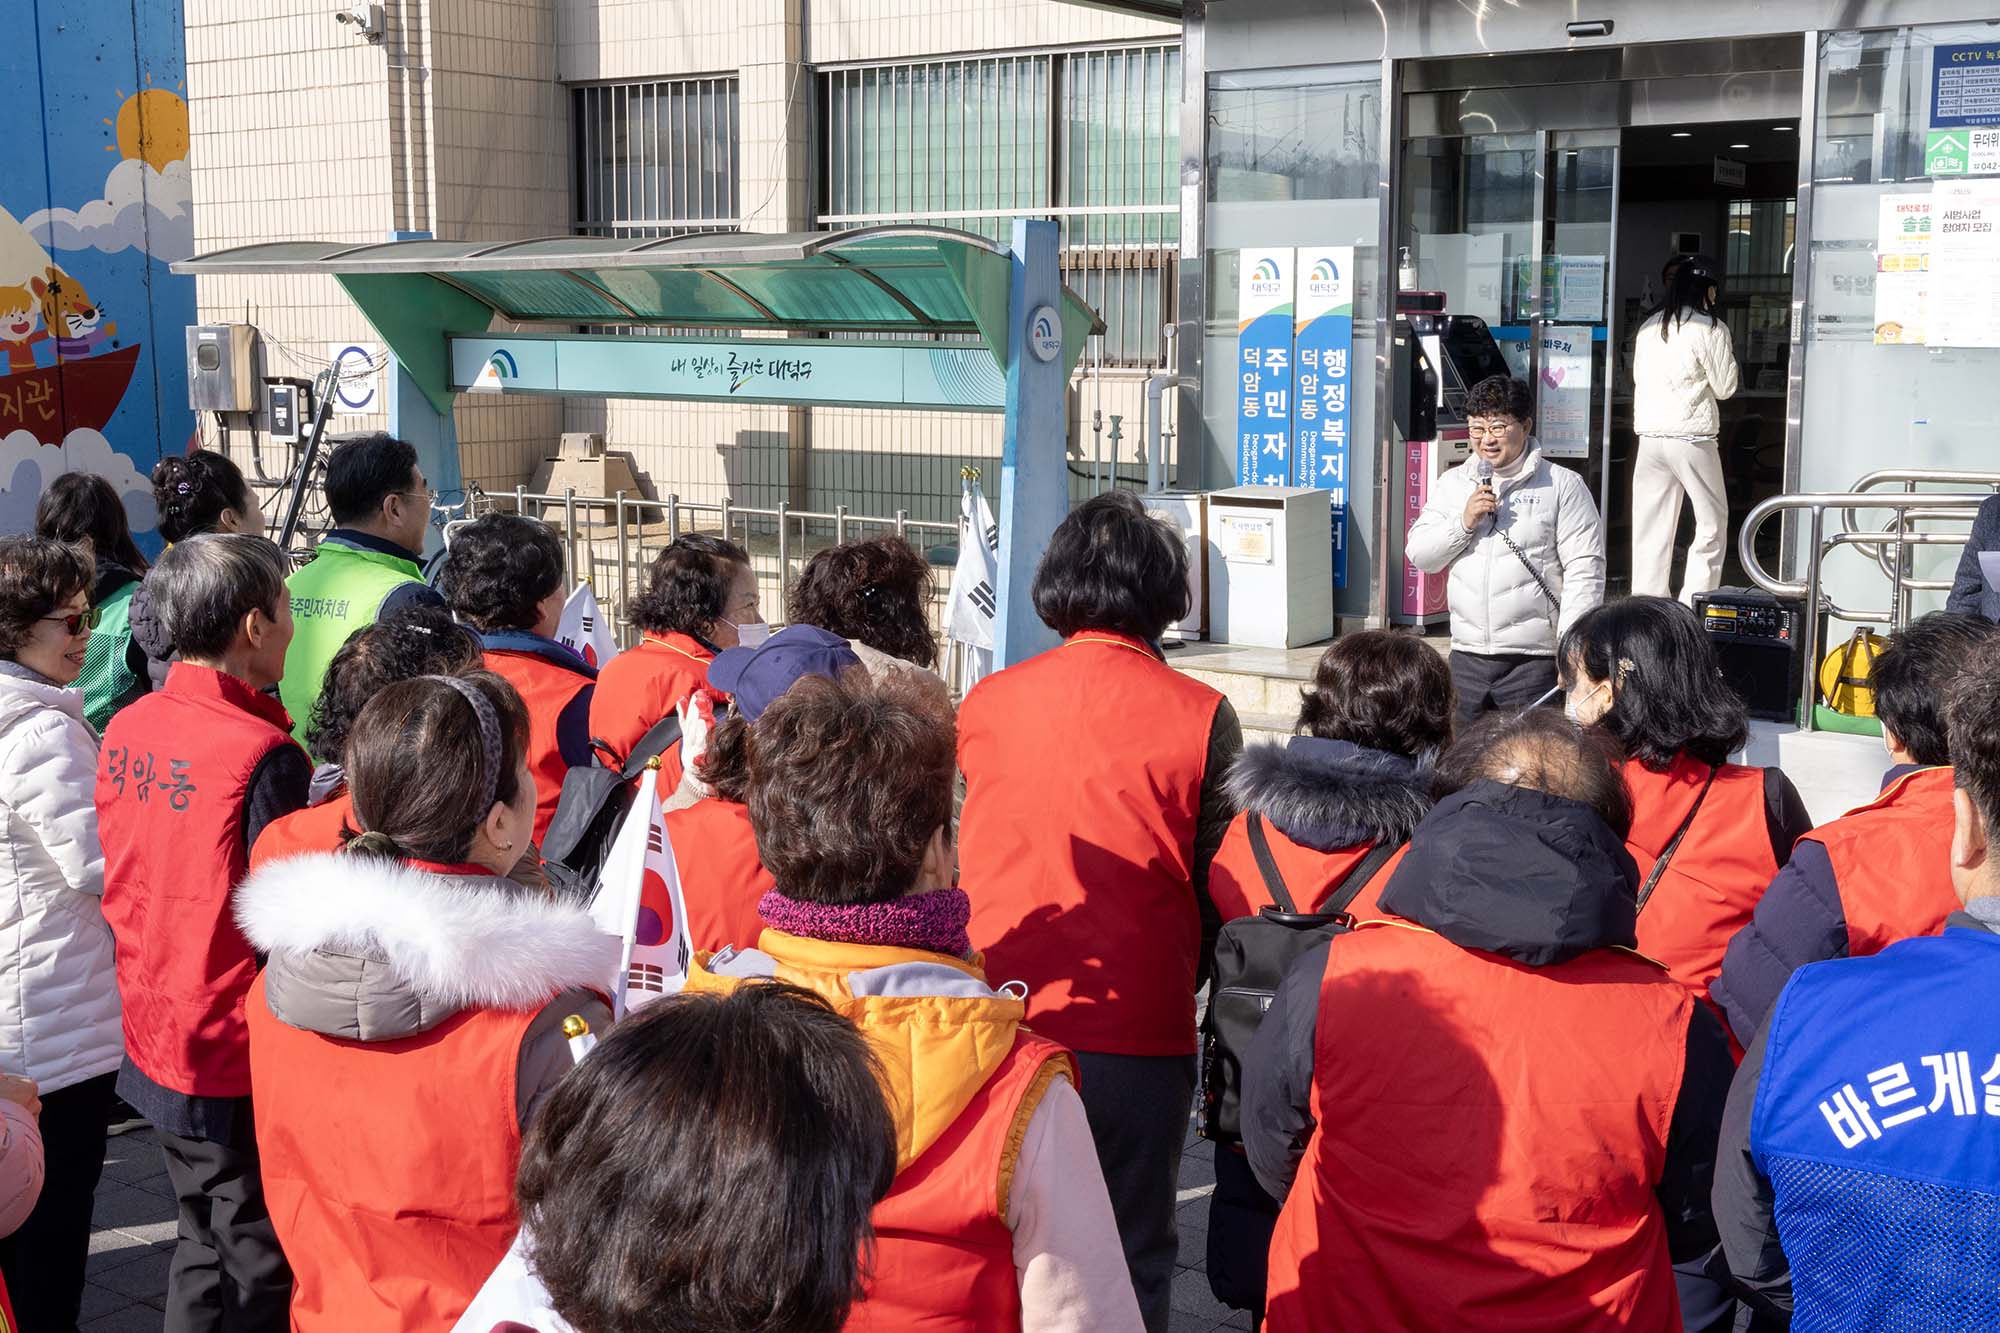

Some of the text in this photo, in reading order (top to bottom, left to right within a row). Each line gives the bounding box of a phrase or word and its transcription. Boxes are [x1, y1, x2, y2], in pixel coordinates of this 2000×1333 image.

[1951, 51, 1982, 62] CCTV
[1973, 132, 2000, 148] 무더위
[1972, 223, 1992, 233] 모집
[1252, 283, 1281, 293] 대덕구
[1309, 283, 1339, 293] 대덕구
[1515, 339, 1572, 353] 에바우처
[671, 352, 812, 394] 내 일상이 즐거운 대덕구
[1242, 347, 1261, 418] 덕암동
[1300, 348, 1319, 420] 덕암동
[1251, 433, 1260, 486] Deogam-do
[1299, 430, 1309, 481] Community
[108, 746, 197, 812] 덕암동
